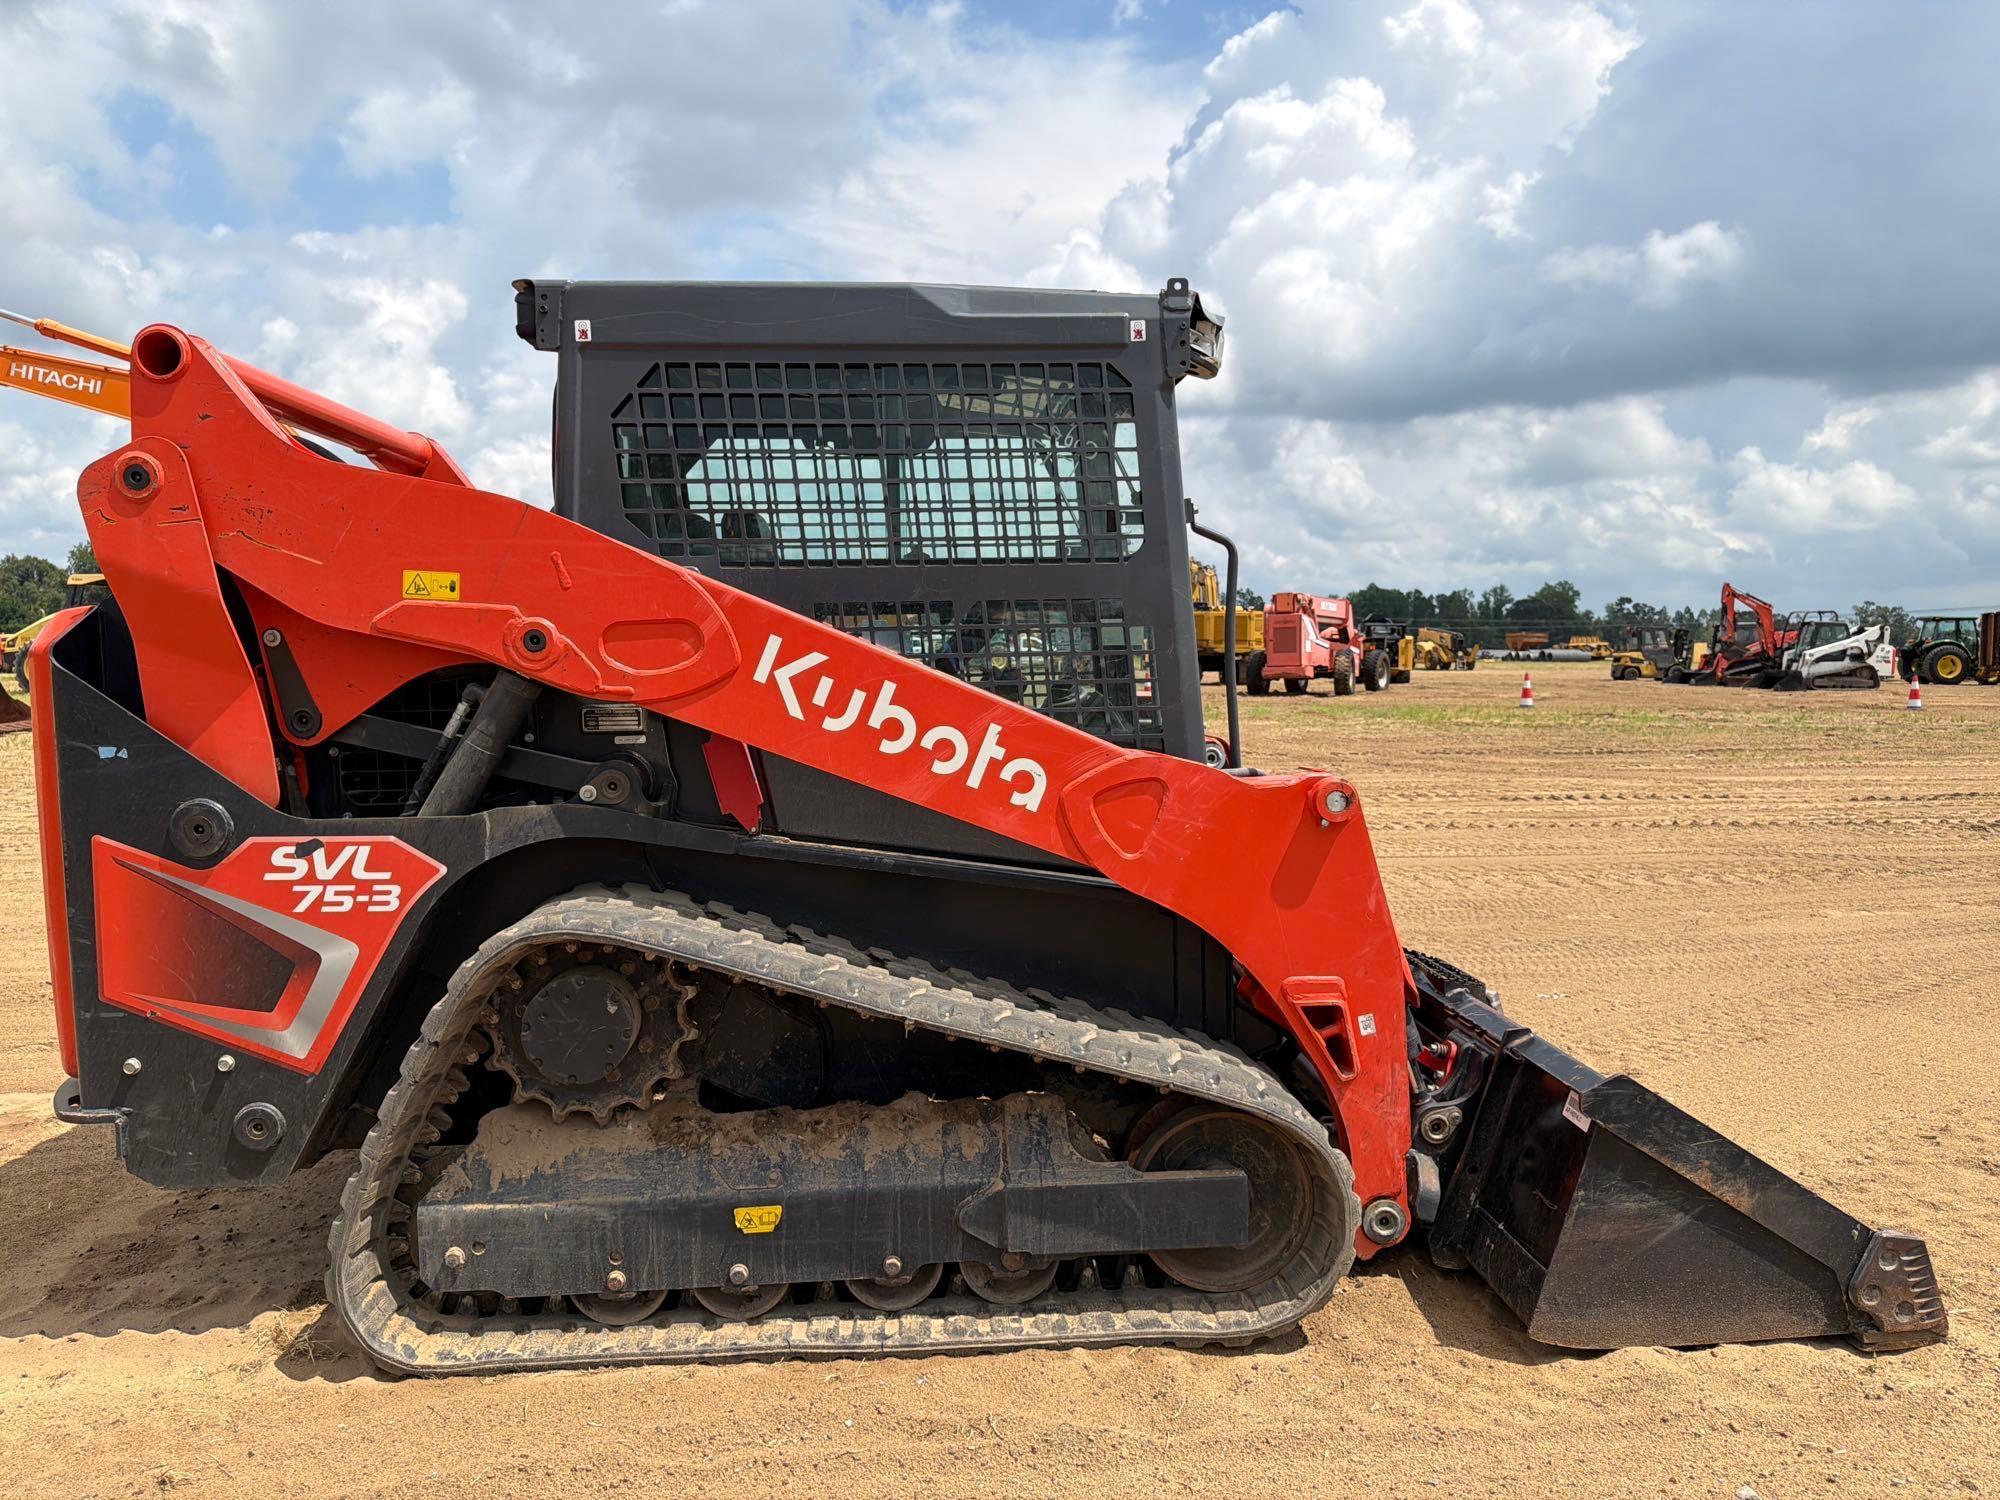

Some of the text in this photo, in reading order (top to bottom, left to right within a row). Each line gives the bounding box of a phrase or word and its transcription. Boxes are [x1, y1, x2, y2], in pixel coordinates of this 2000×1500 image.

[10, 362, 102, 395] HITACHI
[752, 633, 1047, 813] Kubota
[263, 845, 393, 881] SVL
[292, 884, 402, 913] 75-3
